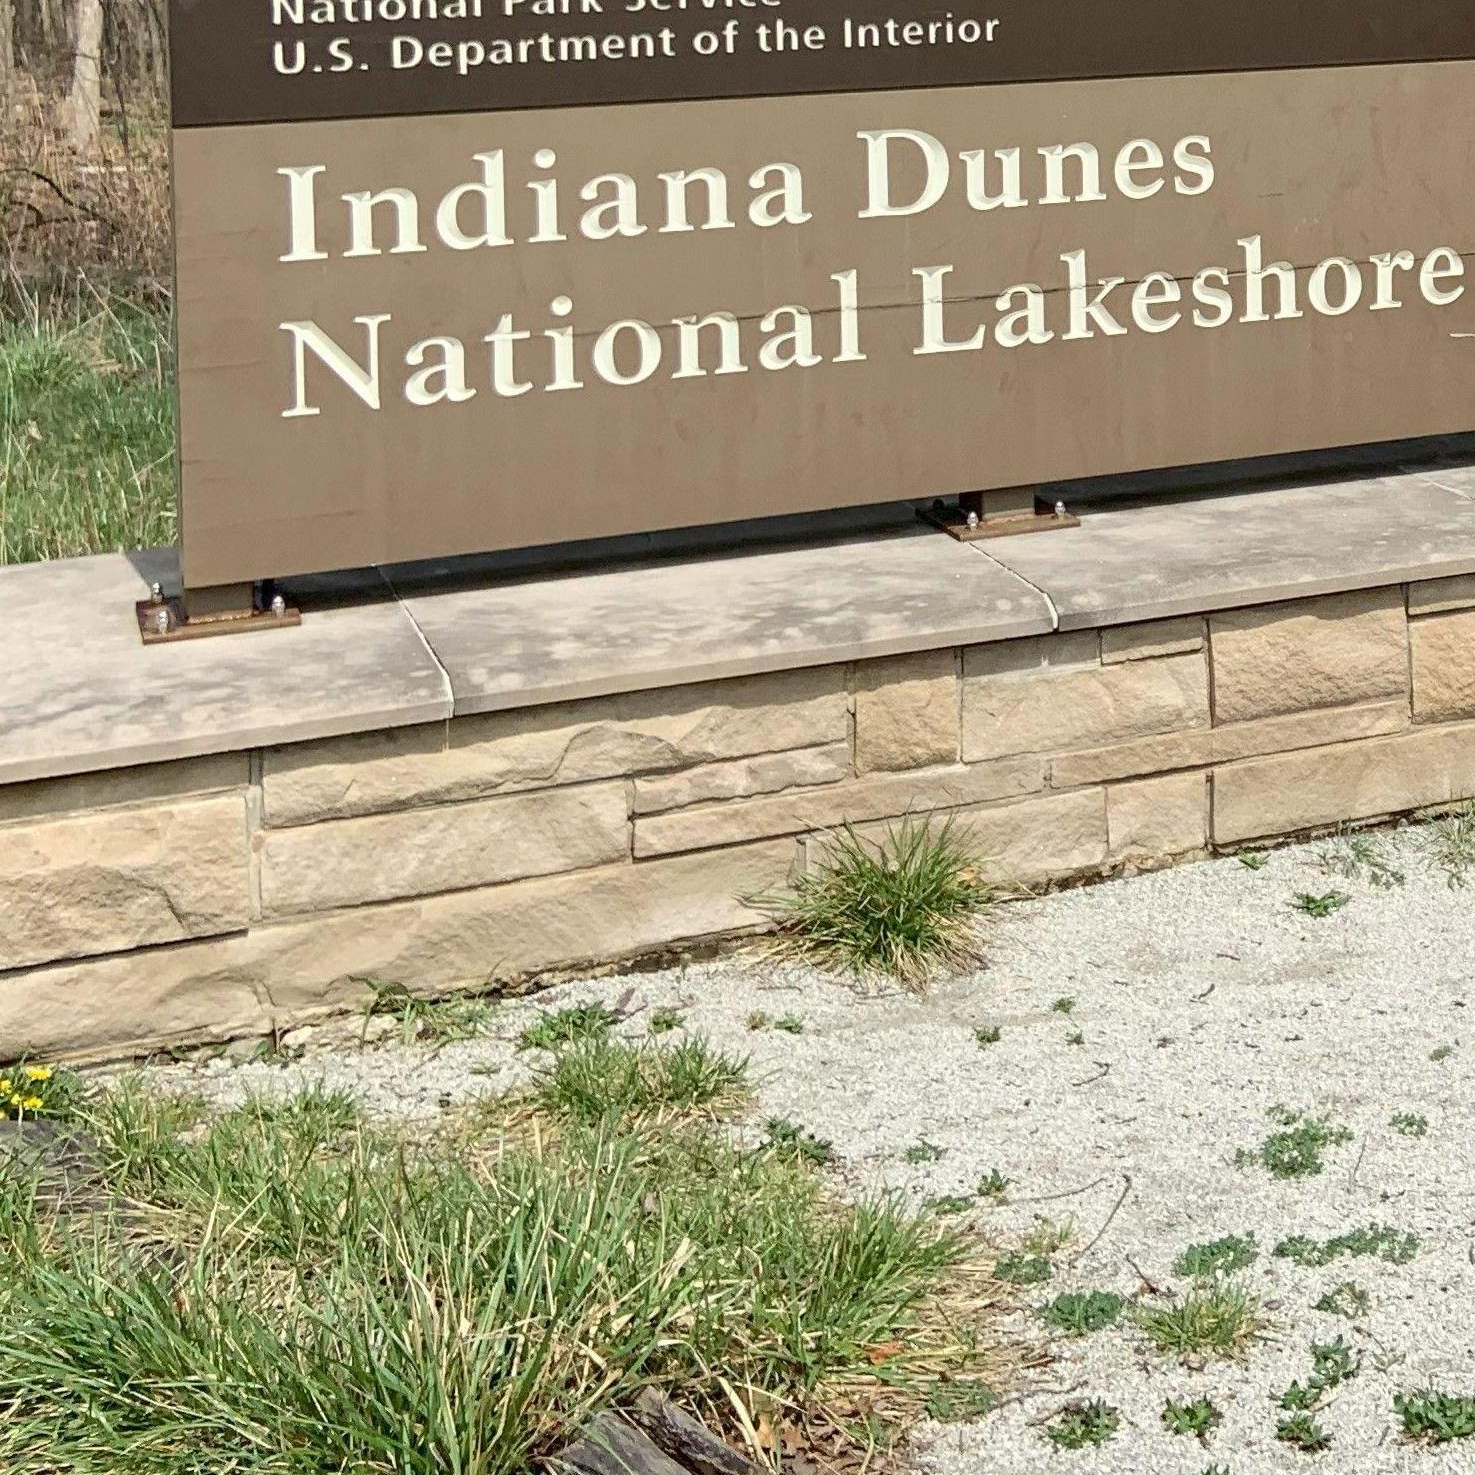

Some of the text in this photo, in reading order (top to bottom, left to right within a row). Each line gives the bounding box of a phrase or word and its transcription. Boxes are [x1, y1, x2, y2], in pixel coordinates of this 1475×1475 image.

[273, 13, 1000, 75] U.S. Department of the Interior
[275, 128, 1215, 263] Indiana Dunes
[279, 235, 1467, 419] National Lakeshore
